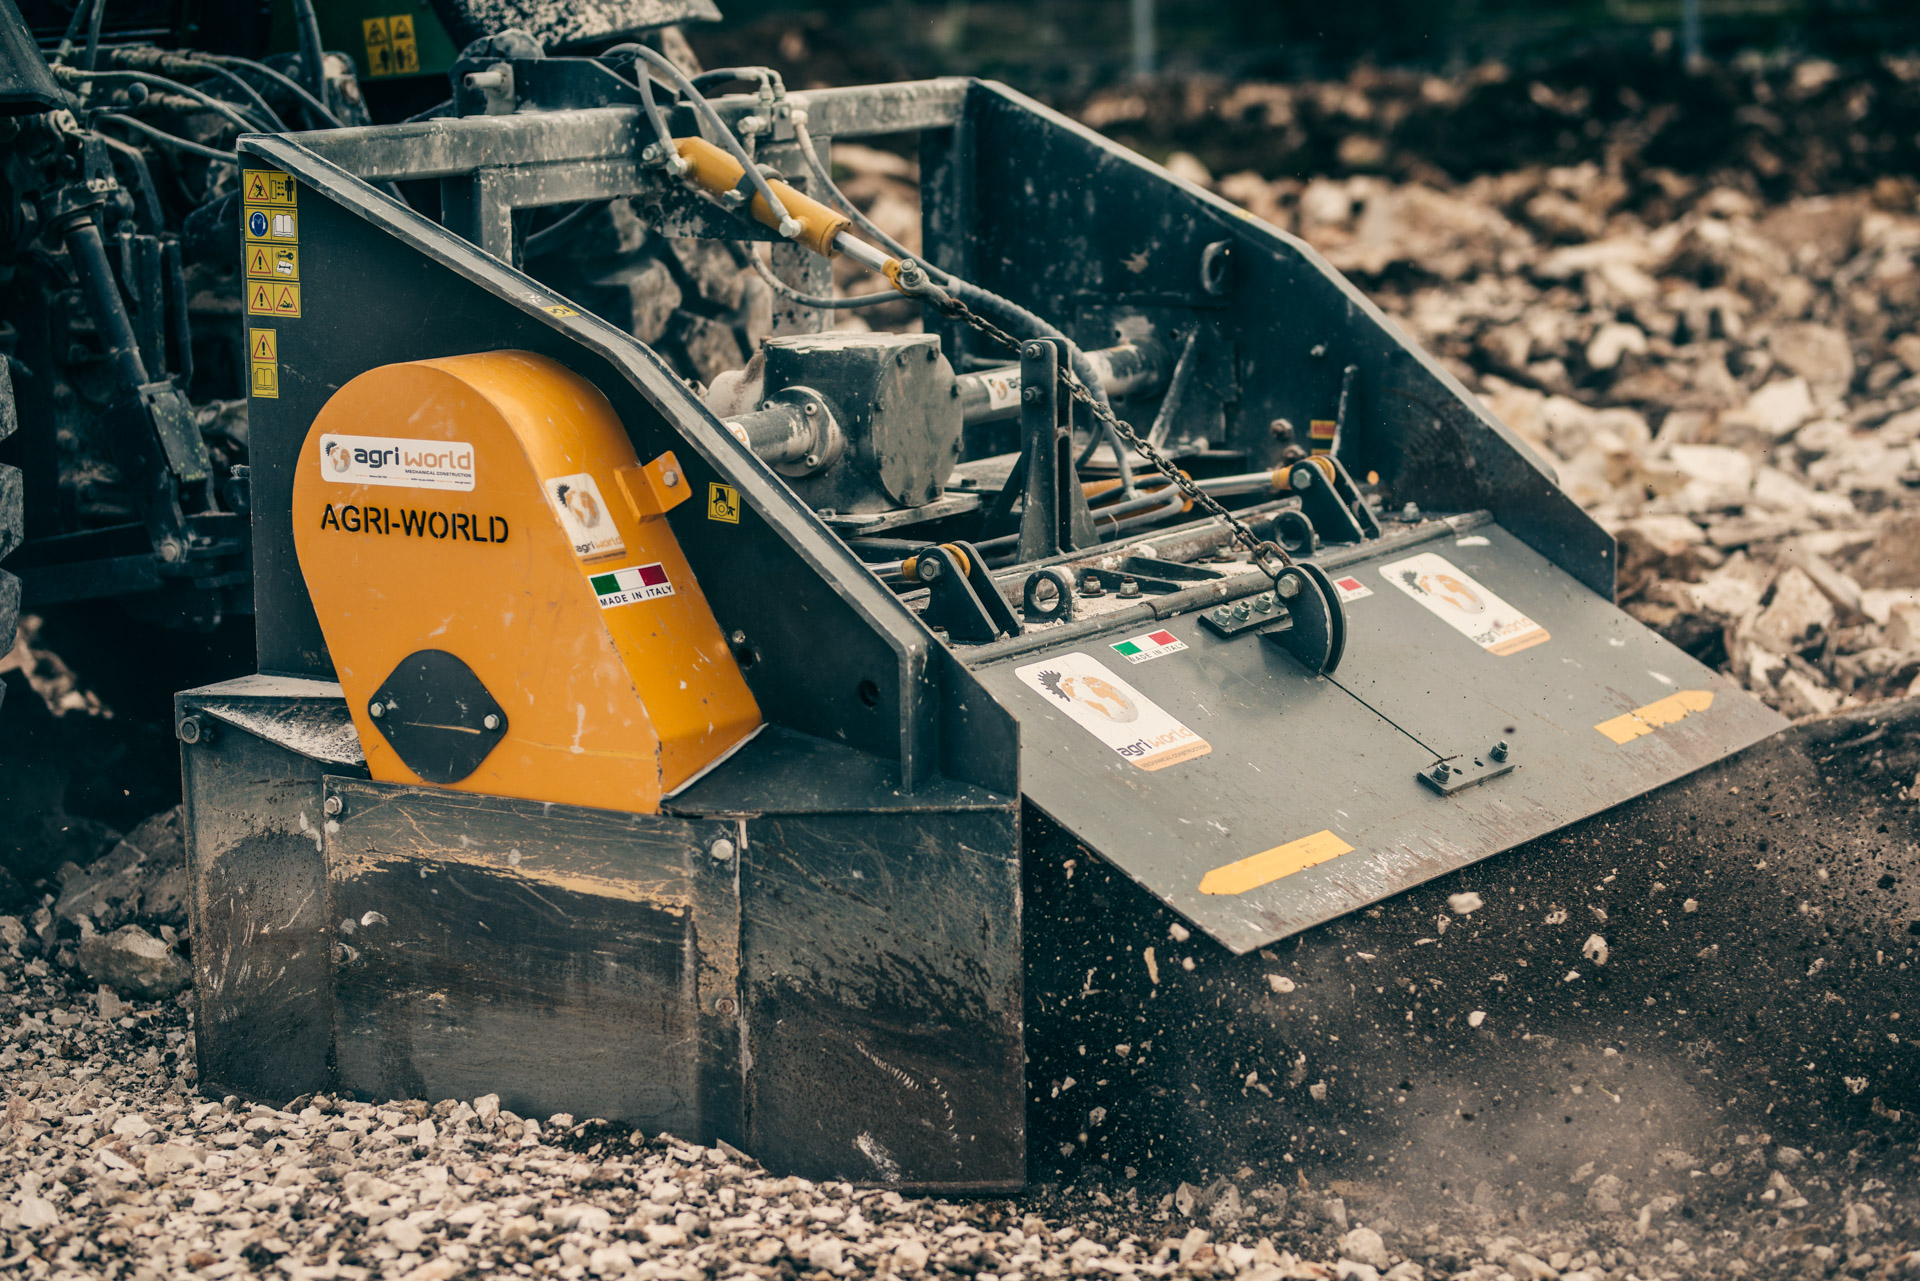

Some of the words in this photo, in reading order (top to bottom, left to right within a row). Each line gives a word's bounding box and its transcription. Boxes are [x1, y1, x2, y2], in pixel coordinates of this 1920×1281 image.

[354, 446, 399, 468] agri
[404, 450, 471, 470] world
[321, 503, 509, 543] AGRI-WORLD
[575, 541, 595, 554] agri
[595, 537, 623, 549] world
[600, 594, 629, 607] MADE
[632, 591, 643, 600] IN
[646, 585, 673, 598] ITALY
[1162, 642, 1186, 653] ITALY
[1116, 738, 1153, 757] agri
[1146, 726, 1195, 748] world
